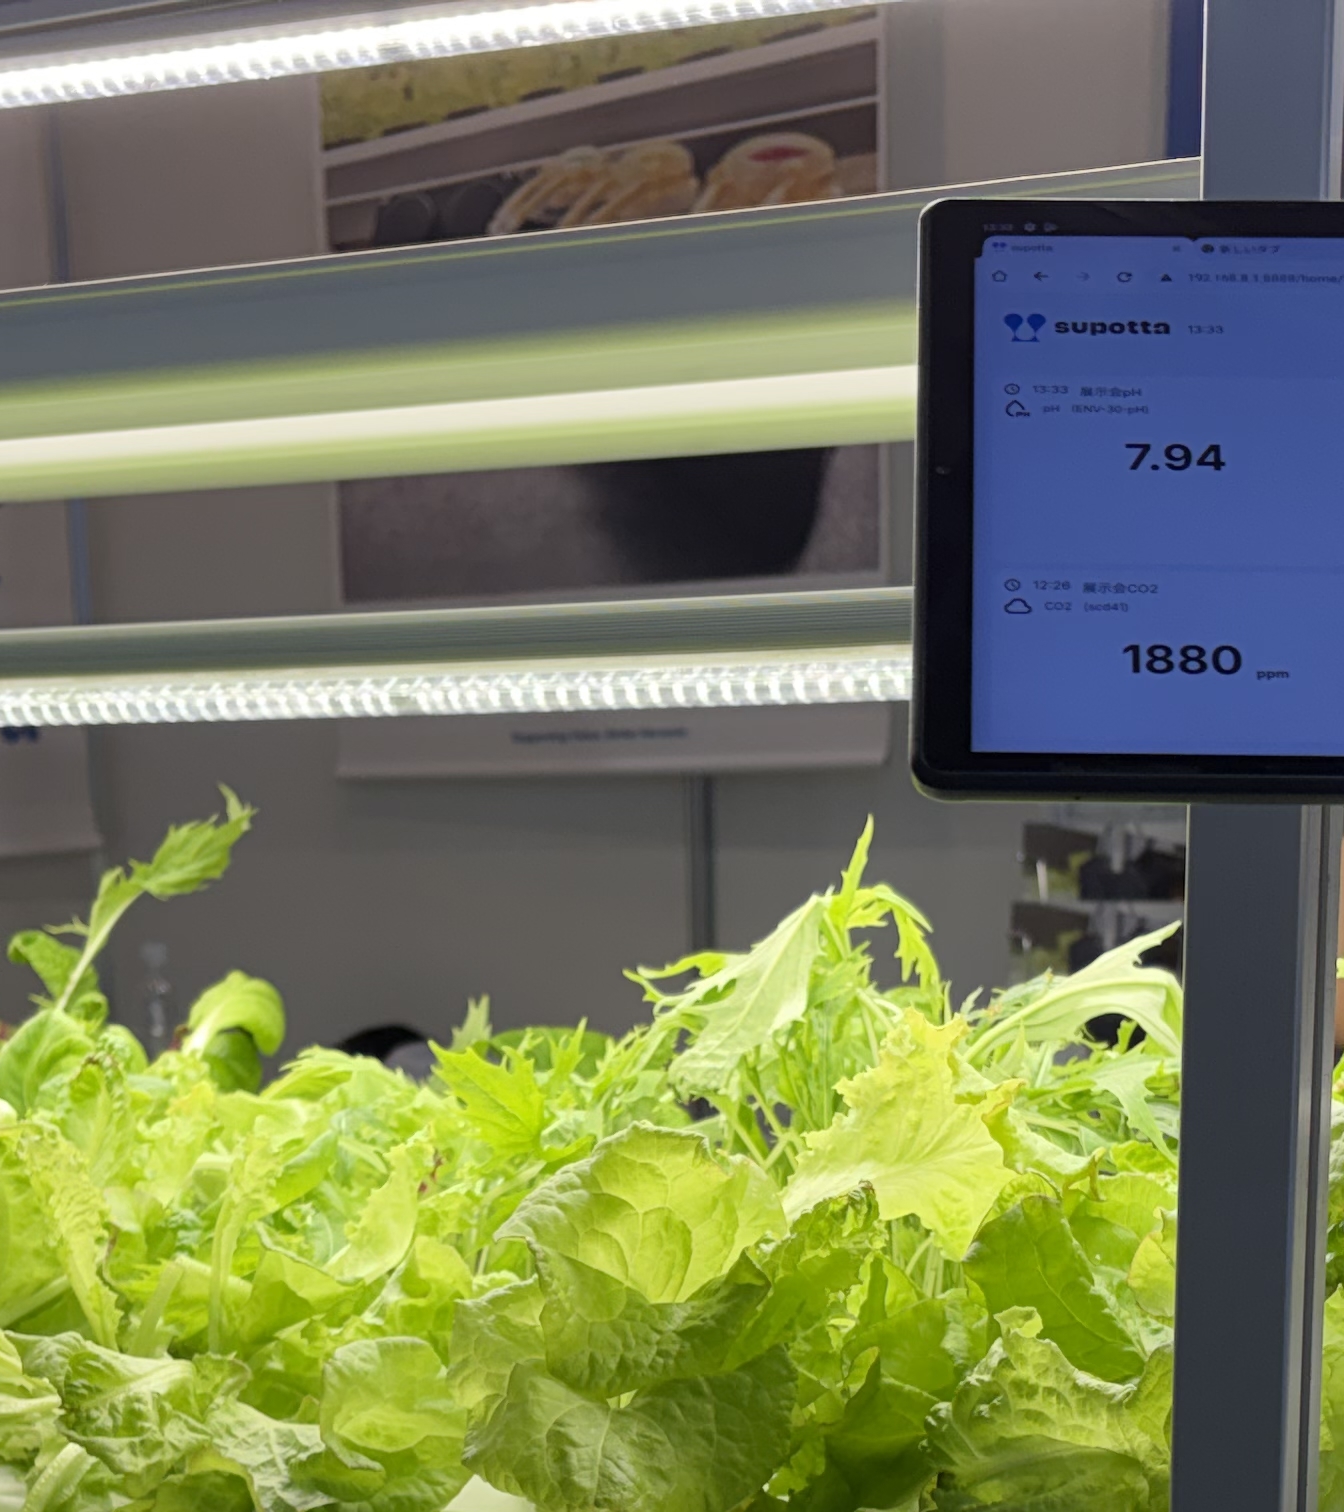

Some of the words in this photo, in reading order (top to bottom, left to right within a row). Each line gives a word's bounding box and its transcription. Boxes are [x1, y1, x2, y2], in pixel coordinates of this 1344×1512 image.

[1055, 320, 1171, 337] supotta
[1188, 325, 1224, 334] 13:33
[1032, 385, 1069, 394] 13:33
[1125, 443, 1226, 472] 7.94
[1033, 580, 1071, 590] 12:26
[1044, 602, 1072, 612] CO2
[1123, 644, 1242, 675] 1880
[1256, 670, 1290, 681] ppm
